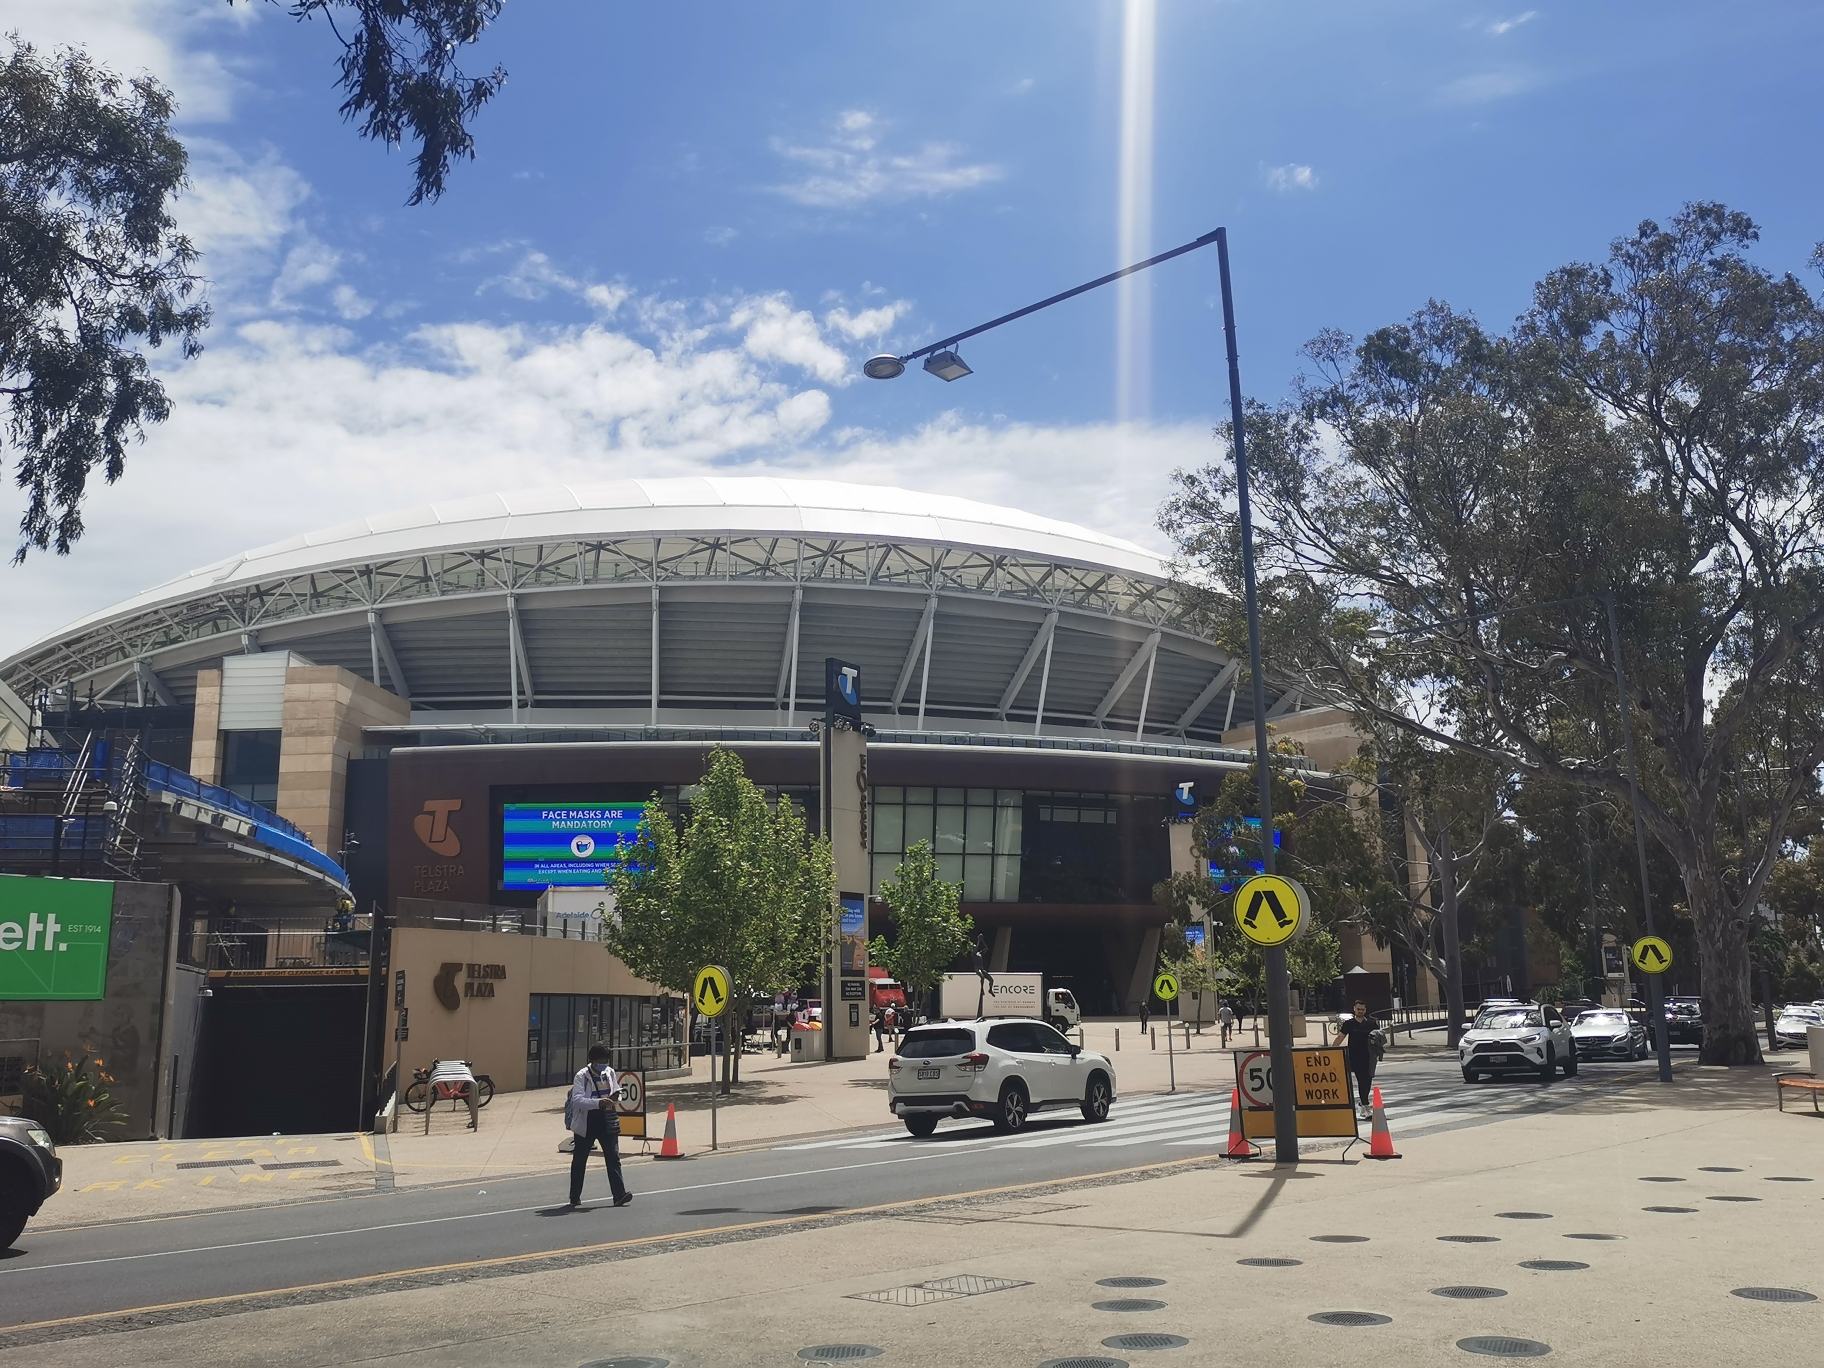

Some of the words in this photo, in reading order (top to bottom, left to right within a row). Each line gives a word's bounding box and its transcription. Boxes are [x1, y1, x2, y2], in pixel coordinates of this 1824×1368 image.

[542, 810, 567, 819] FACE
[569, 810, 602, 819] MASKS
[603, 810, 624, 819] ARE
[552, 820, 614, 829] MANDATORY
[414, 864, 465, 878] TELSTRA
[414, 880, 450, 892] PLAZA
[68, 924, 83, 933] EST
[85, 925, 102, 933] 1914
[466, 963, 506, 979] TELSTRA
[464, 982, 495, 997] PLAZA
[993, 985, 1035, 994] ENCORE
[1306, 1056, 1331, 1067] END
[1304, 1072, 1337, 1083] ROAD
[621, 1083, 638, 1101] 50
[1305, 1089, 1340, 1100] WORK
